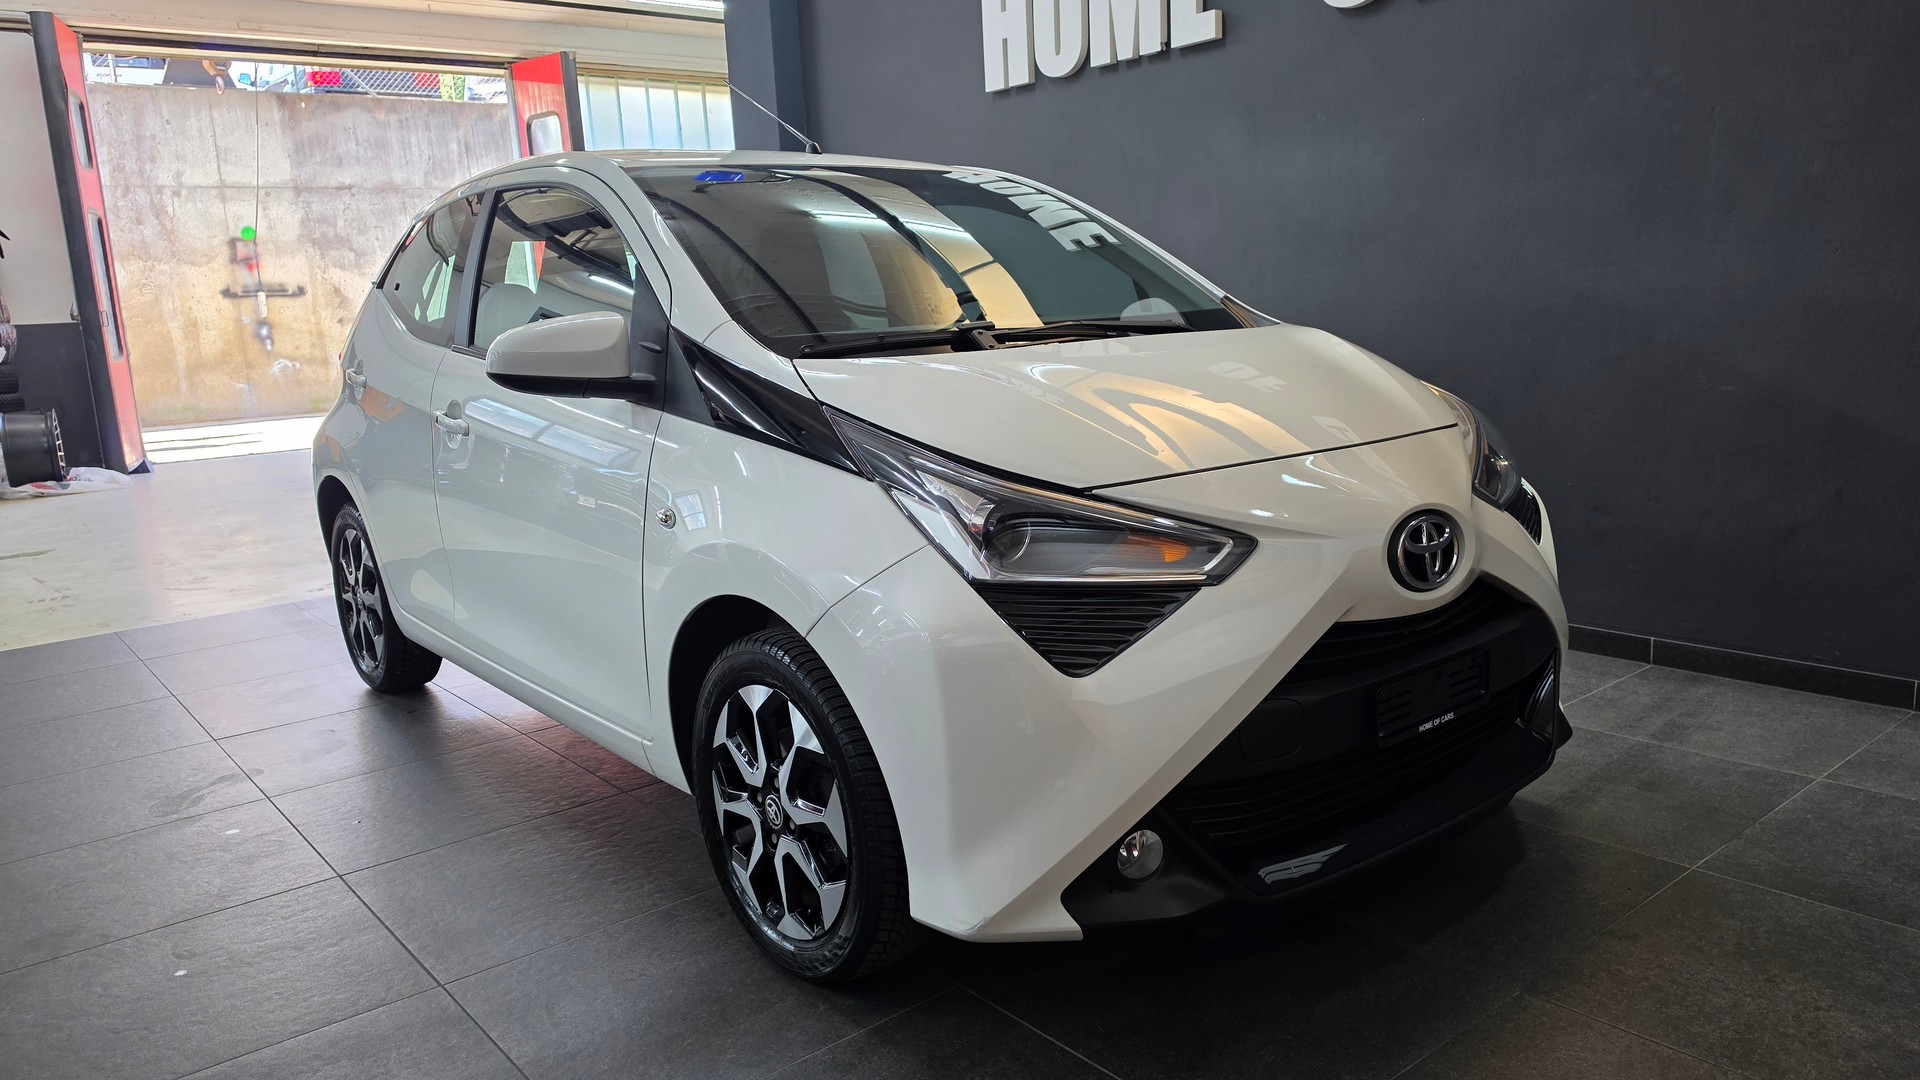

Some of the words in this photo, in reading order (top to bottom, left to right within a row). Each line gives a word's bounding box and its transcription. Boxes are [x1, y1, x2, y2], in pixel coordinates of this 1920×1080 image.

[1419, 721, 1433, 732] HOME
[1433, 717, 1440, 726] OF
[1440, 712, 1454, 723] CARS
